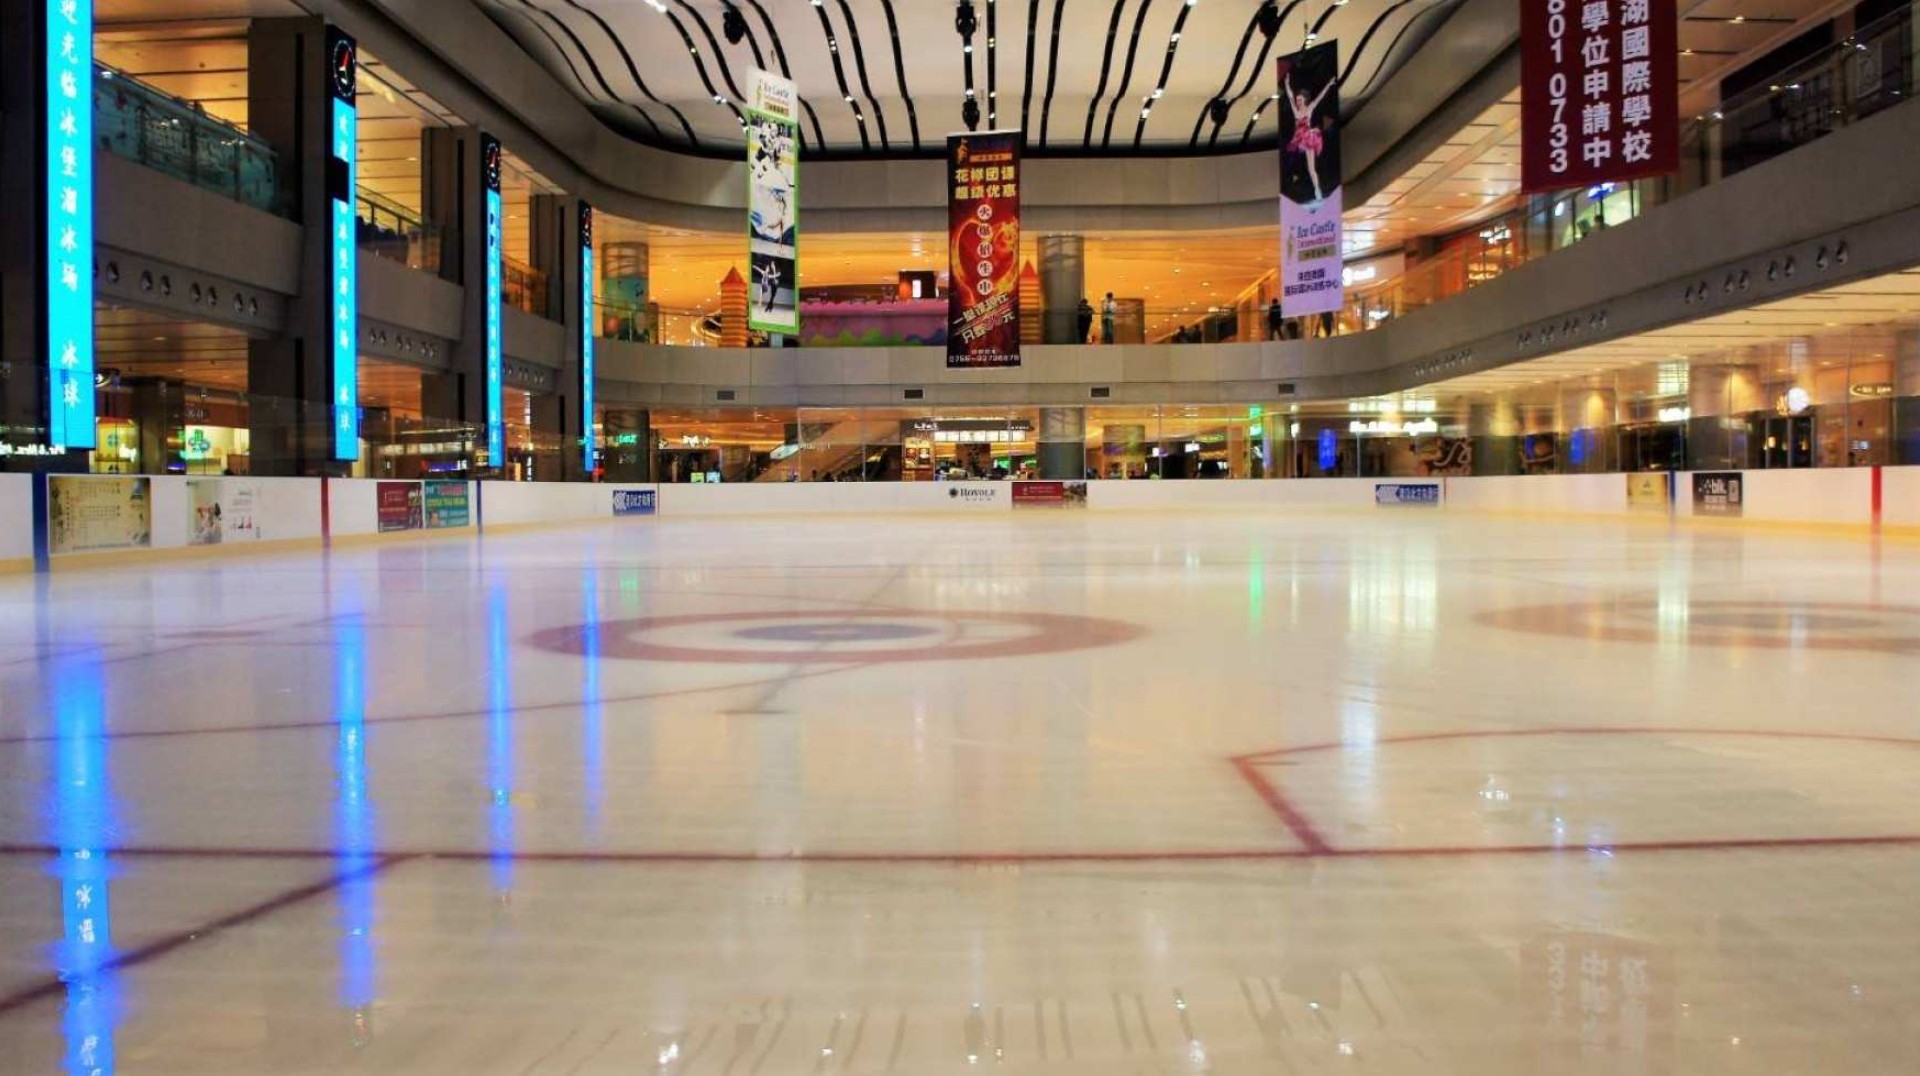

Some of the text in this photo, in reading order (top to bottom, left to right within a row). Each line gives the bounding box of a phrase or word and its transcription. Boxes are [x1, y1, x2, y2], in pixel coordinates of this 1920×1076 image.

[1549, 73, 1568, 173] 0733
[1581, 2, 1611, 168] 學位申請中
[1620, 0, 1652, 163] 湖國際學校
